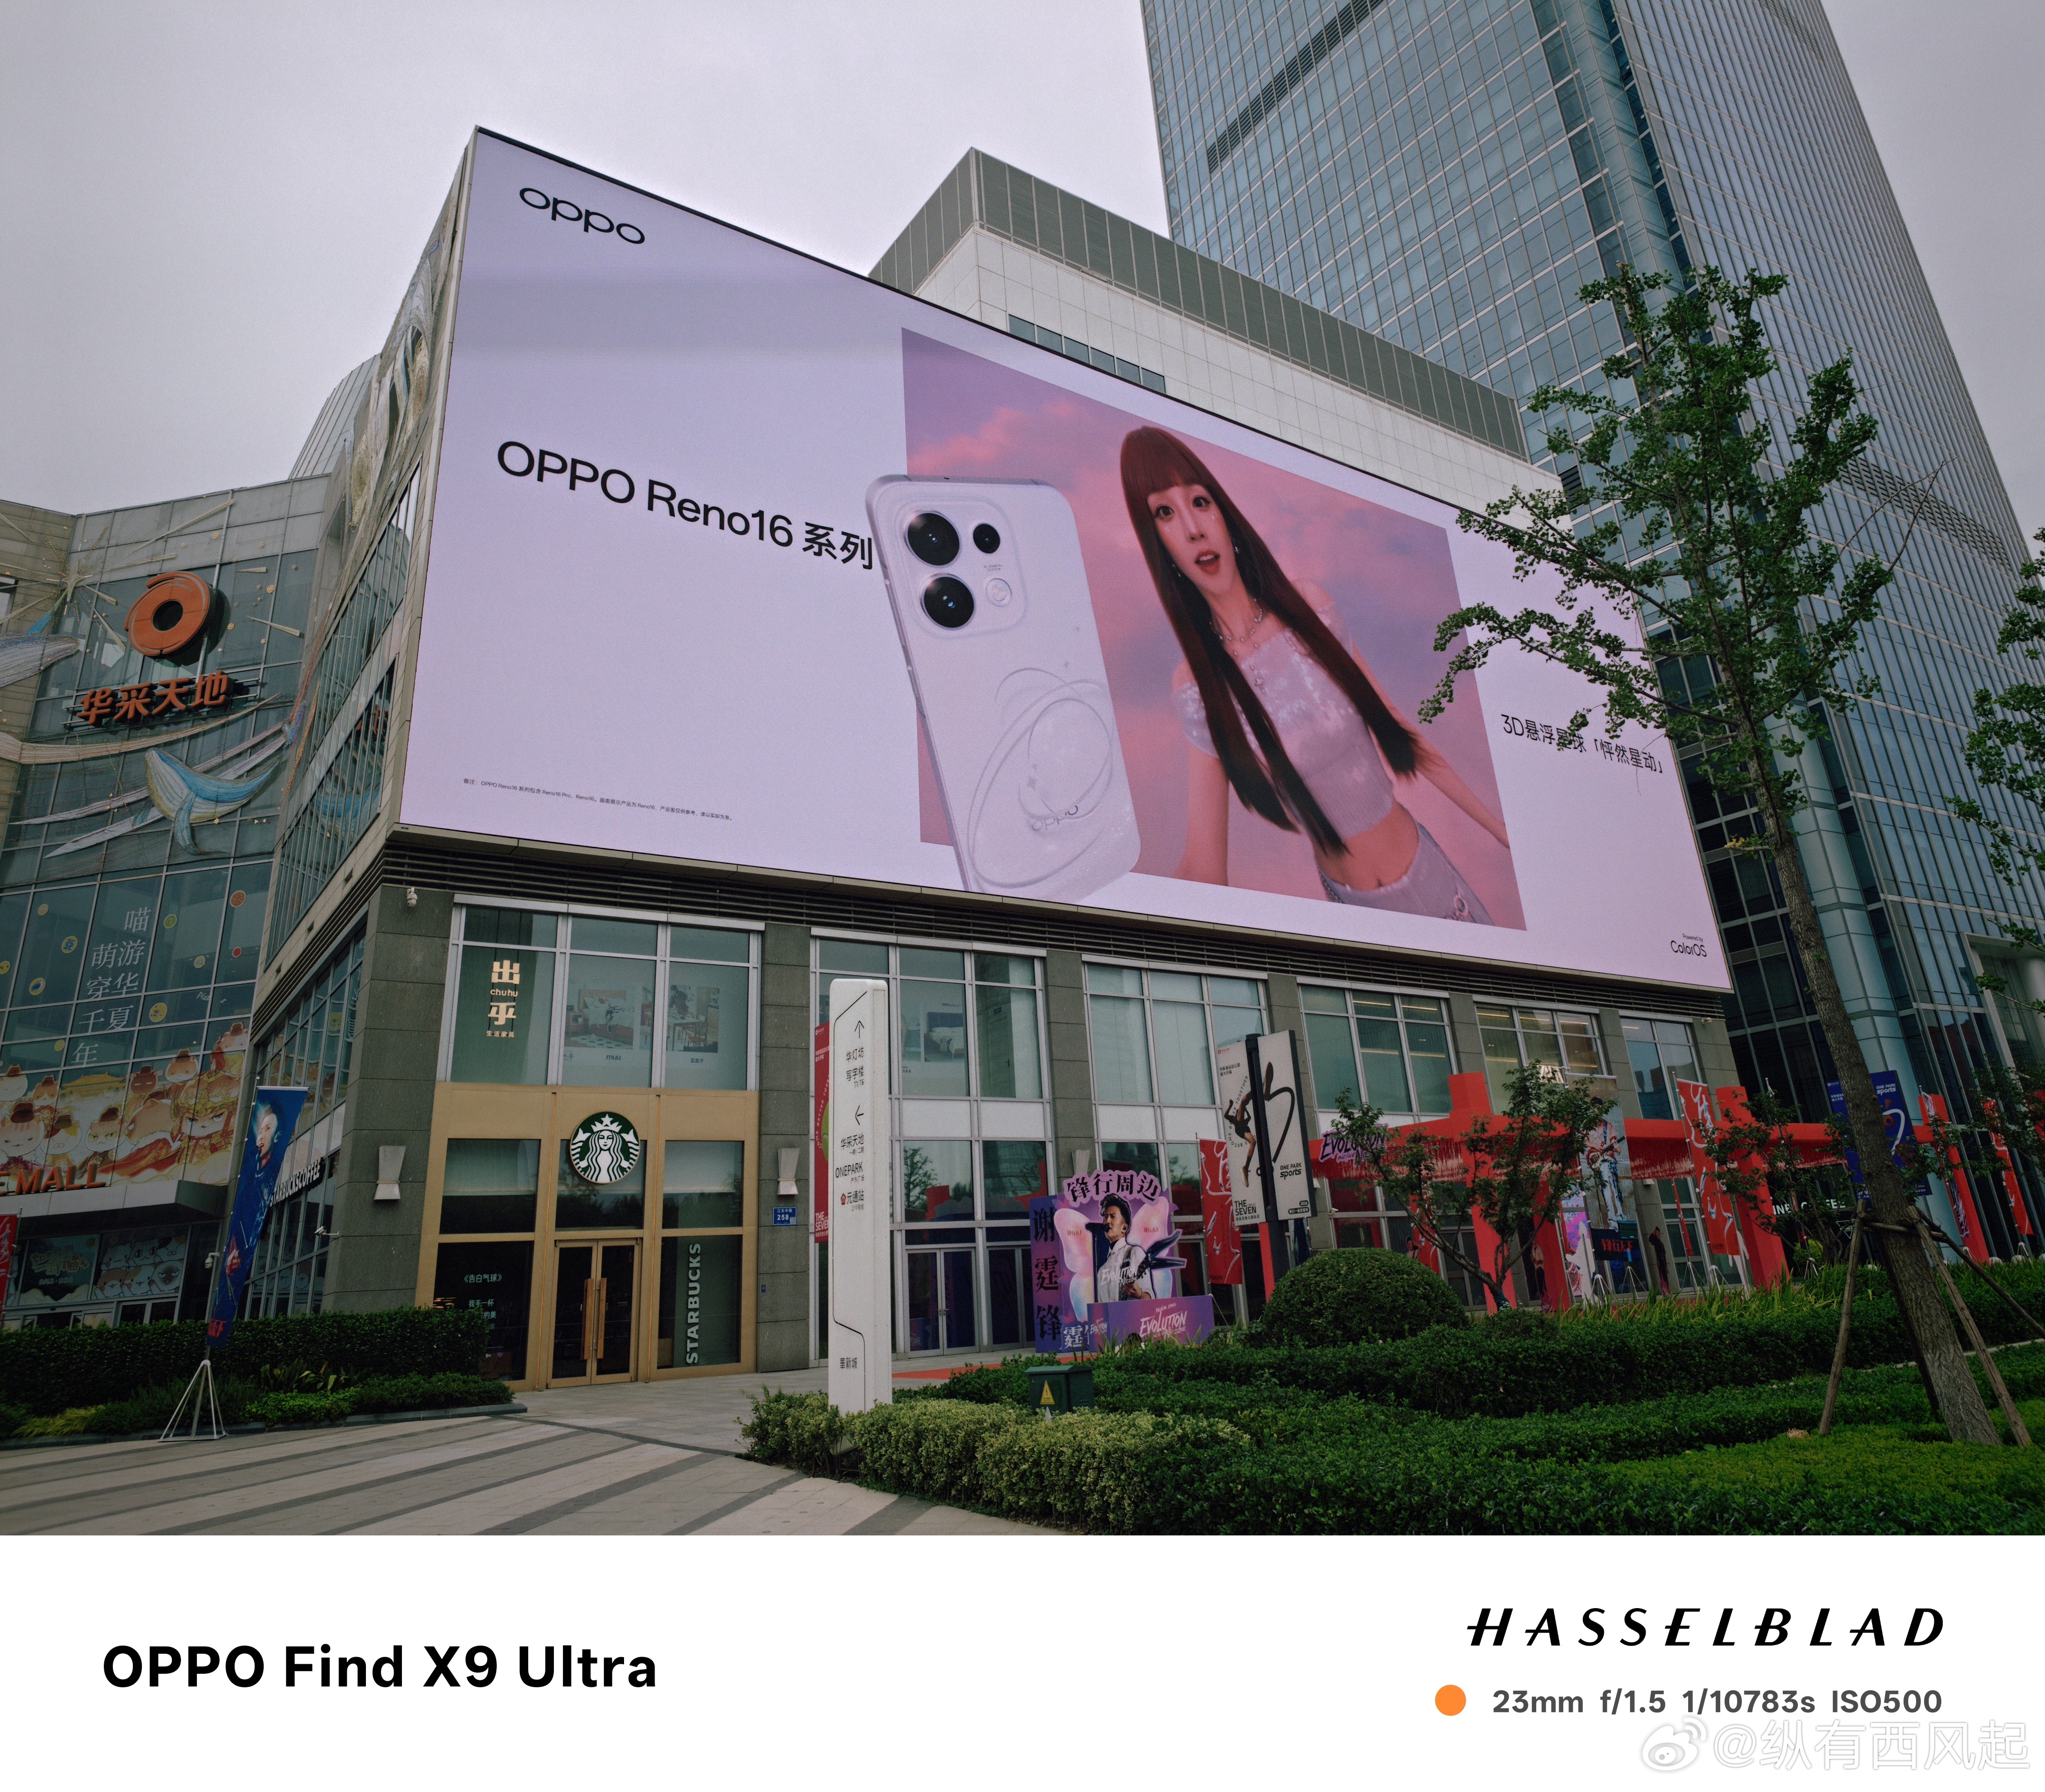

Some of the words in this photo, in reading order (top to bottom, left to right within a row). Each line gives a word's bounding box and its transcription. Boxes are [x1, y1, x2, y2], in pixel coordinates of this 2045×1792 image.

[498, 440, 635, 503] OPPO
[647, 479, 793, 547] Reno16
[802, 522, 873, 570] 系列
[77, 669, 229, 725] 华采天地
[498, 783, 517, 791] Reno16
[519, 786, 541, 794] 系列包含
[1671, 940, 1707, 957] ColorOS
[491, 960, 520, 984] 出
[490, 989, 518, 997] chuhu
[488, 1002, 517, 1025] 乎
[486, 1030, 515, 1038] 生活家具
[846, 1046, 864, 1062] 华灯坊
[846, 1065, 864, 1081] 写字楼
[1236, 1075, 1248, 1104] TOGETHER
[1877, 1087, 1896, 1095] sports
[841, 1133, 865, 1150] 华采天地
[835, 1161, 863, 1178] ONEPARK
[1280, 1169, 1302, 1180] sports
[15, 1164, 105, 1195] MALL
[851, 1175, 865, 1184] 户外广场
[1067, 1173, 1159, 1202] 锋行周边
[847, 1189, 864, 1204] 元通站
[1234, 1200, 1247, 1208] THE
[815, 1211, 825, 1222] THE
[1235, 1206, 1257, 1216] SEVEN
[464, 1273, 502, 1283] 《告白气球》
[1033, 1206, 1062, 1341] 谢霆锋
[1101, 1266, 1138, 1286] EVOLUTION
[686, 1243, 701, 1364] STARBUCKS
[1139, 1310, 1187, 1338] EVOLUTION
[840, 1357, 858, 1369] 華新城
